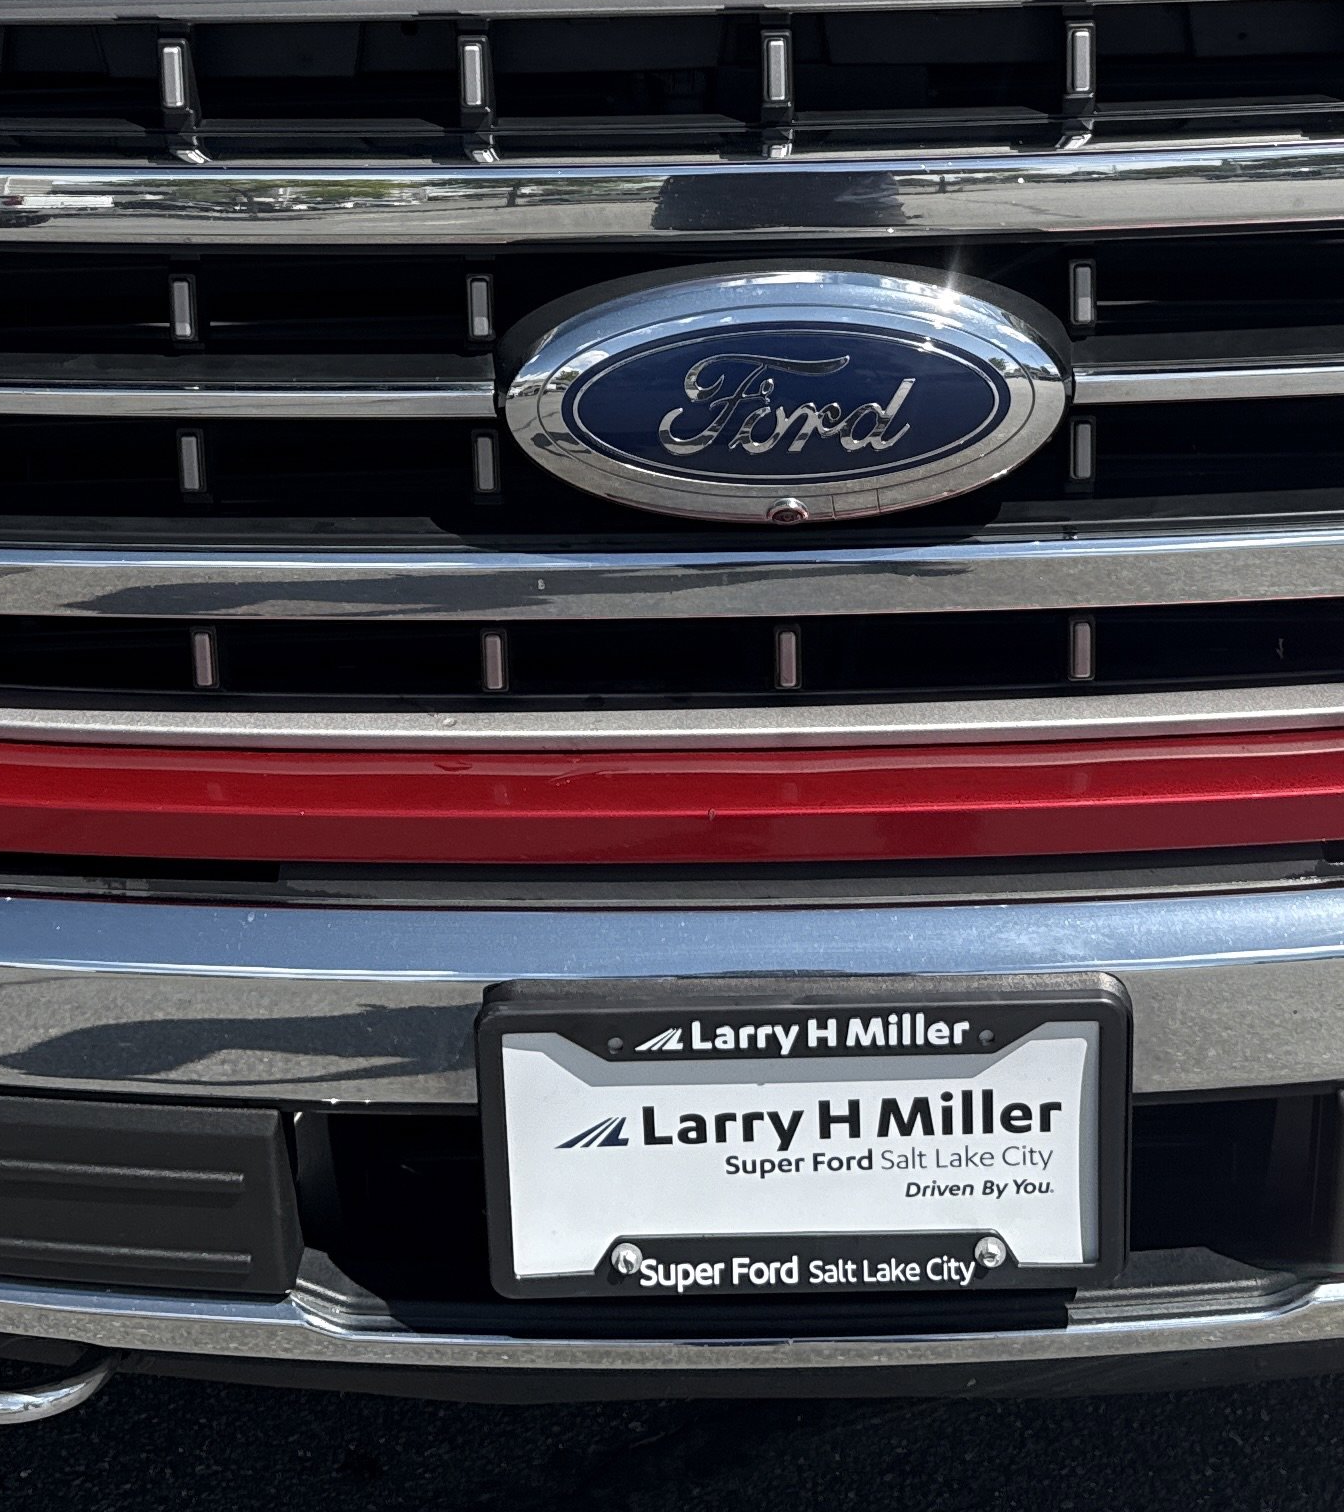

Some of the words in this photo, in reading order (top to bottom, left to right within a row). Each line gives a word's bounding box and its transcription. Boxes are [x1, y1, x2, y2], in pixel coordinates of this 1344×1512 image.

[658, 353, 916, 456] Ford
[691, 1020, 800, 1055] Larry
[807, 1018, 837, 1047] H
[846, 1012, 970, 1047] Miller
[642, 1105, 805, 1152] Larry
[818, 1099, 861, 1140] H
[876, 1088, 1062, 1138] Miller
[725, 1155, 805, 1179] Super
[812, 1148, 873, 1172] Ford
[880, 1146, 928, 1170] Salt
[935, 1145, 995, 1169] Lake
[1002, 1145, 1054, 1171] City
[905, 1179, 975, 1198] Driven
[982, 1179, 1009, 1200] By
[639, 1259, 725, 1294] Super
[732, 1255, 799, 1285] Ford
[808, 1259, 857, 1285] Salt
[863, 1258, 921, 1283] Lake
[926, 1255, 976, 1286] City
